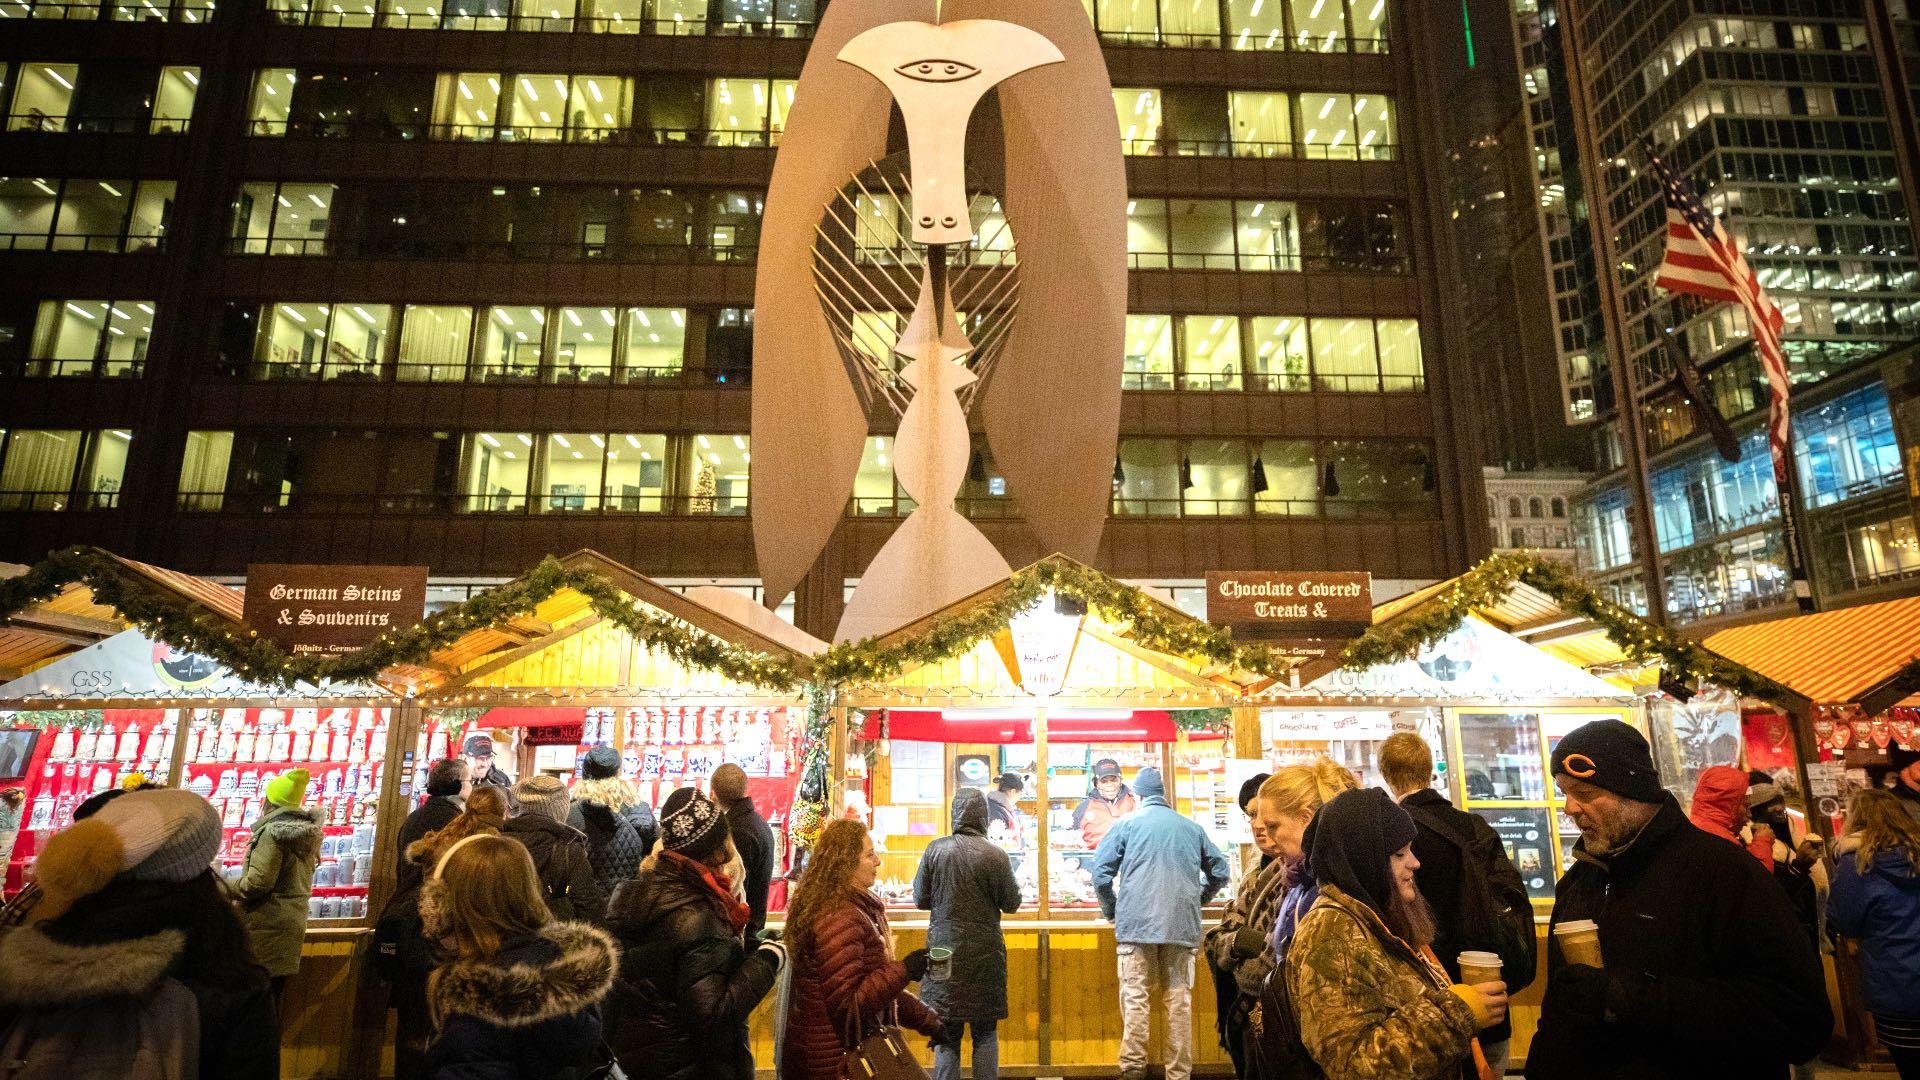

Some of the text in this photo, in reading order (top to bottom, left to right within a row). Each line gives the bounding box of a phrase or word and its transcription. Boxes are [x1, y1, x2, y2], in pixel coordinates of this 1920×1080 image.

[269, 583, 402, 602] German Steins
[1219, 580, 1361, 599] Chocolate Covered
[277, 608, 390, 627] & Souvenirs
[1254, 601, 1328, 618] Treats &
[329, 644, 363, 653] German
[1292, 647, 1326, 657] Germany
[72, 670, 112, 687] GSS
[1279, 723, 1319, 731] CHOCOLATE
[1333, 715, 1359, 730] COFFEE
